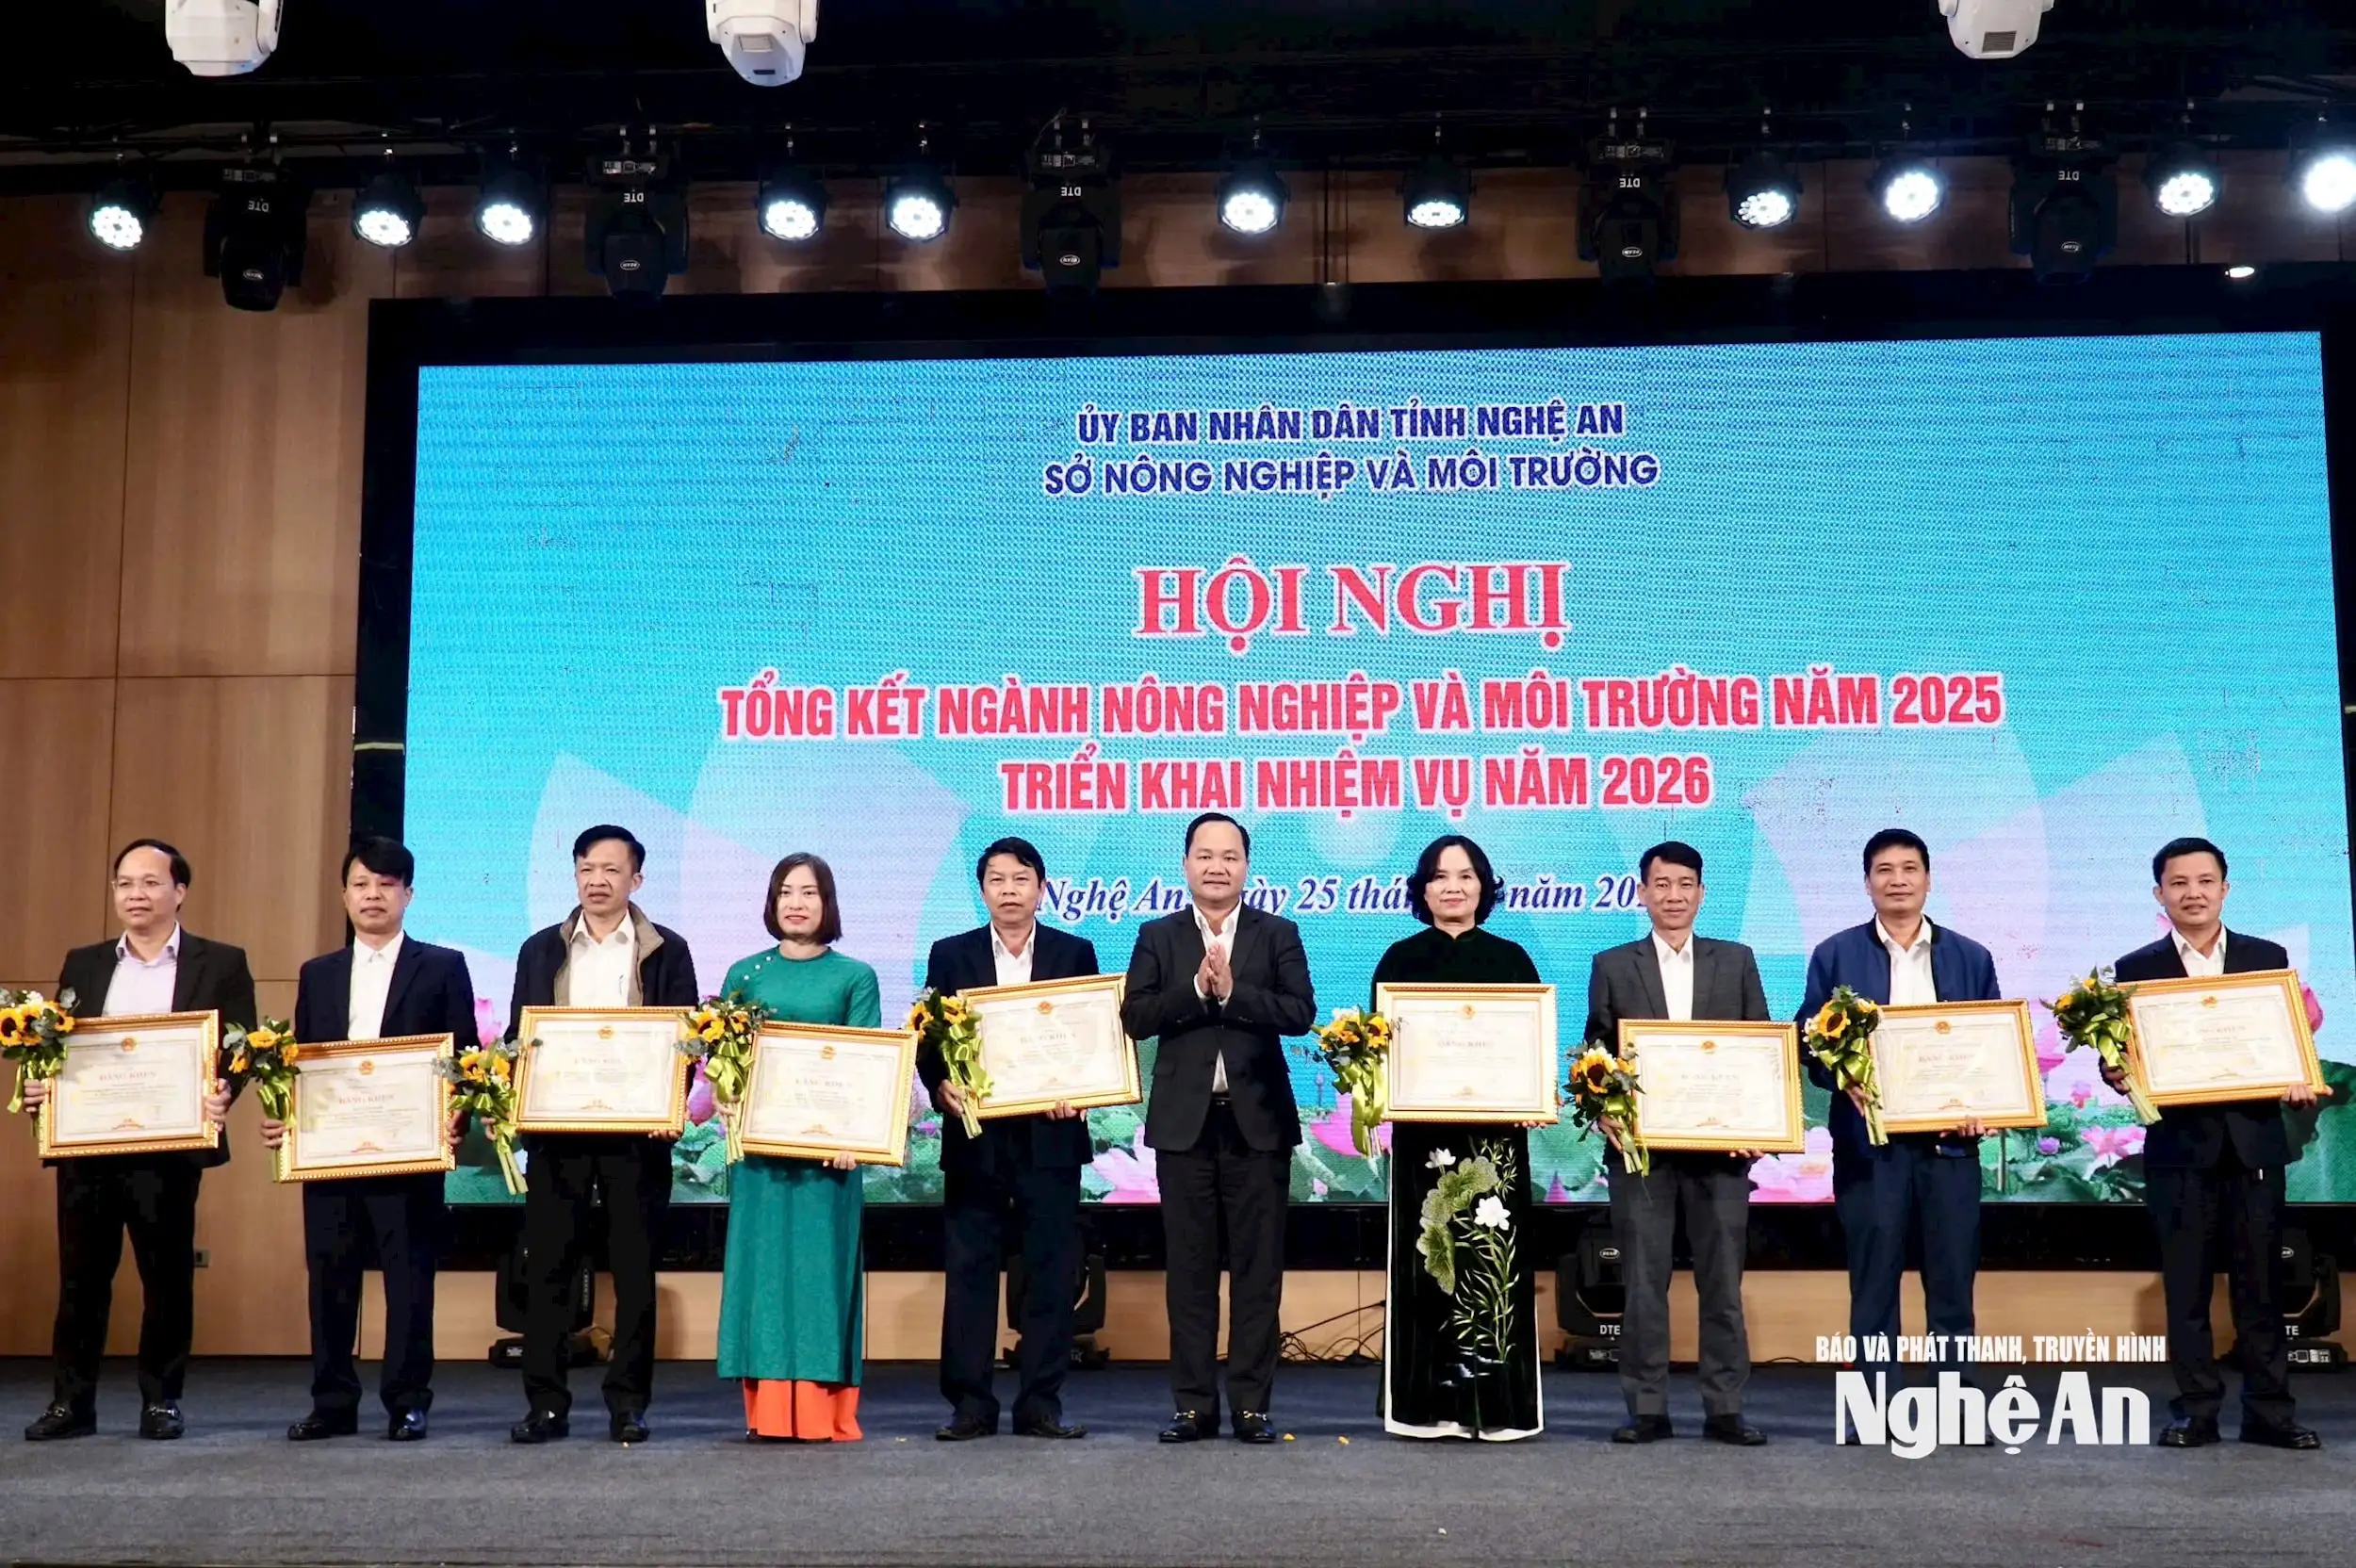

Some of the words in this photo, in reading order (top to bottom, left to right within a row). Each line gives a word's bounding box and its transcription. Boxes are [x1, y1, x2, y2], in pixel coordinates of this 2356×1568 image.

[2058, 171, 2079, 181] DTE
[1619, 178, 1640, 188] DTE
[623, 192, 644, 203] DTE
[1061, 187, 1081, 196] DTE
[248, 200, 270, 212] DTE
[1079, 404, 1119, 442] ỦY
[1132, 414, 1197, 442] BAN
[1210, 405, 1301, 440] NHÂN
[1313, 403, 1380, 438] DÂN
[1391, 399, 1465, 437] TỈNH
[1478, 400, 1565, 441] NGHỆ
[1575, 405, 1623, 433] AN
[1046, 453, 1092, 494] SỞ
[1106, 455, 1212, 493] NÔNG
[1225, 452, 1355, 498] NGHIỆP
[1367, 450, 1415, 489] VÀ
[1429, 449, 1497, 487] MÔI
[1510, 448, 1658, 485] TRƯỜNG
[1136, 557, 1305, 651] HỘI
[1332, 564, 1566, 647] NGHỊ
[722, 670, 832, 736] TỔNG
[849, 673, 924, 734] KẾT
[940, 678, 1088, 733] NGÀNH
[1104, 676, 1223, 732] NÔNG
[1240, 673, 1399, 741] NGHIỆP
[1415, 671, 1470, 728] VÀ
[1485, 670, 1568, 727] MÔI
[1583, 667, 1759, 727] TRƯỜNG
[1774, 667, 1877, 725] NĂM
[1894, 677, 2001, 724] 2025
[1002, 743, 1126, 808] TRIỂN
[1141, 761, 1241, 808] KHAI
[1258, 750, 1399, 818] NHIỆM
[1415, 760, 1469, 818] VỤ
[1486, 748, 1587, 806] NĂM
[1604, 758, 1710, 805] 2026
[1038, 879, 1126, 920] Nghệ
[1242, 878, 1286, 913] ày
[1297, 878, 1336, 909] 25
[1349, 877, 1413, 909] thá
[1510, 877, 1582, 907] năm
[1595, 876, 1646, 907] 20
[1600, 1325, 1621, 1335] DTE
[2284, 1325, 2299, 1335] TE
